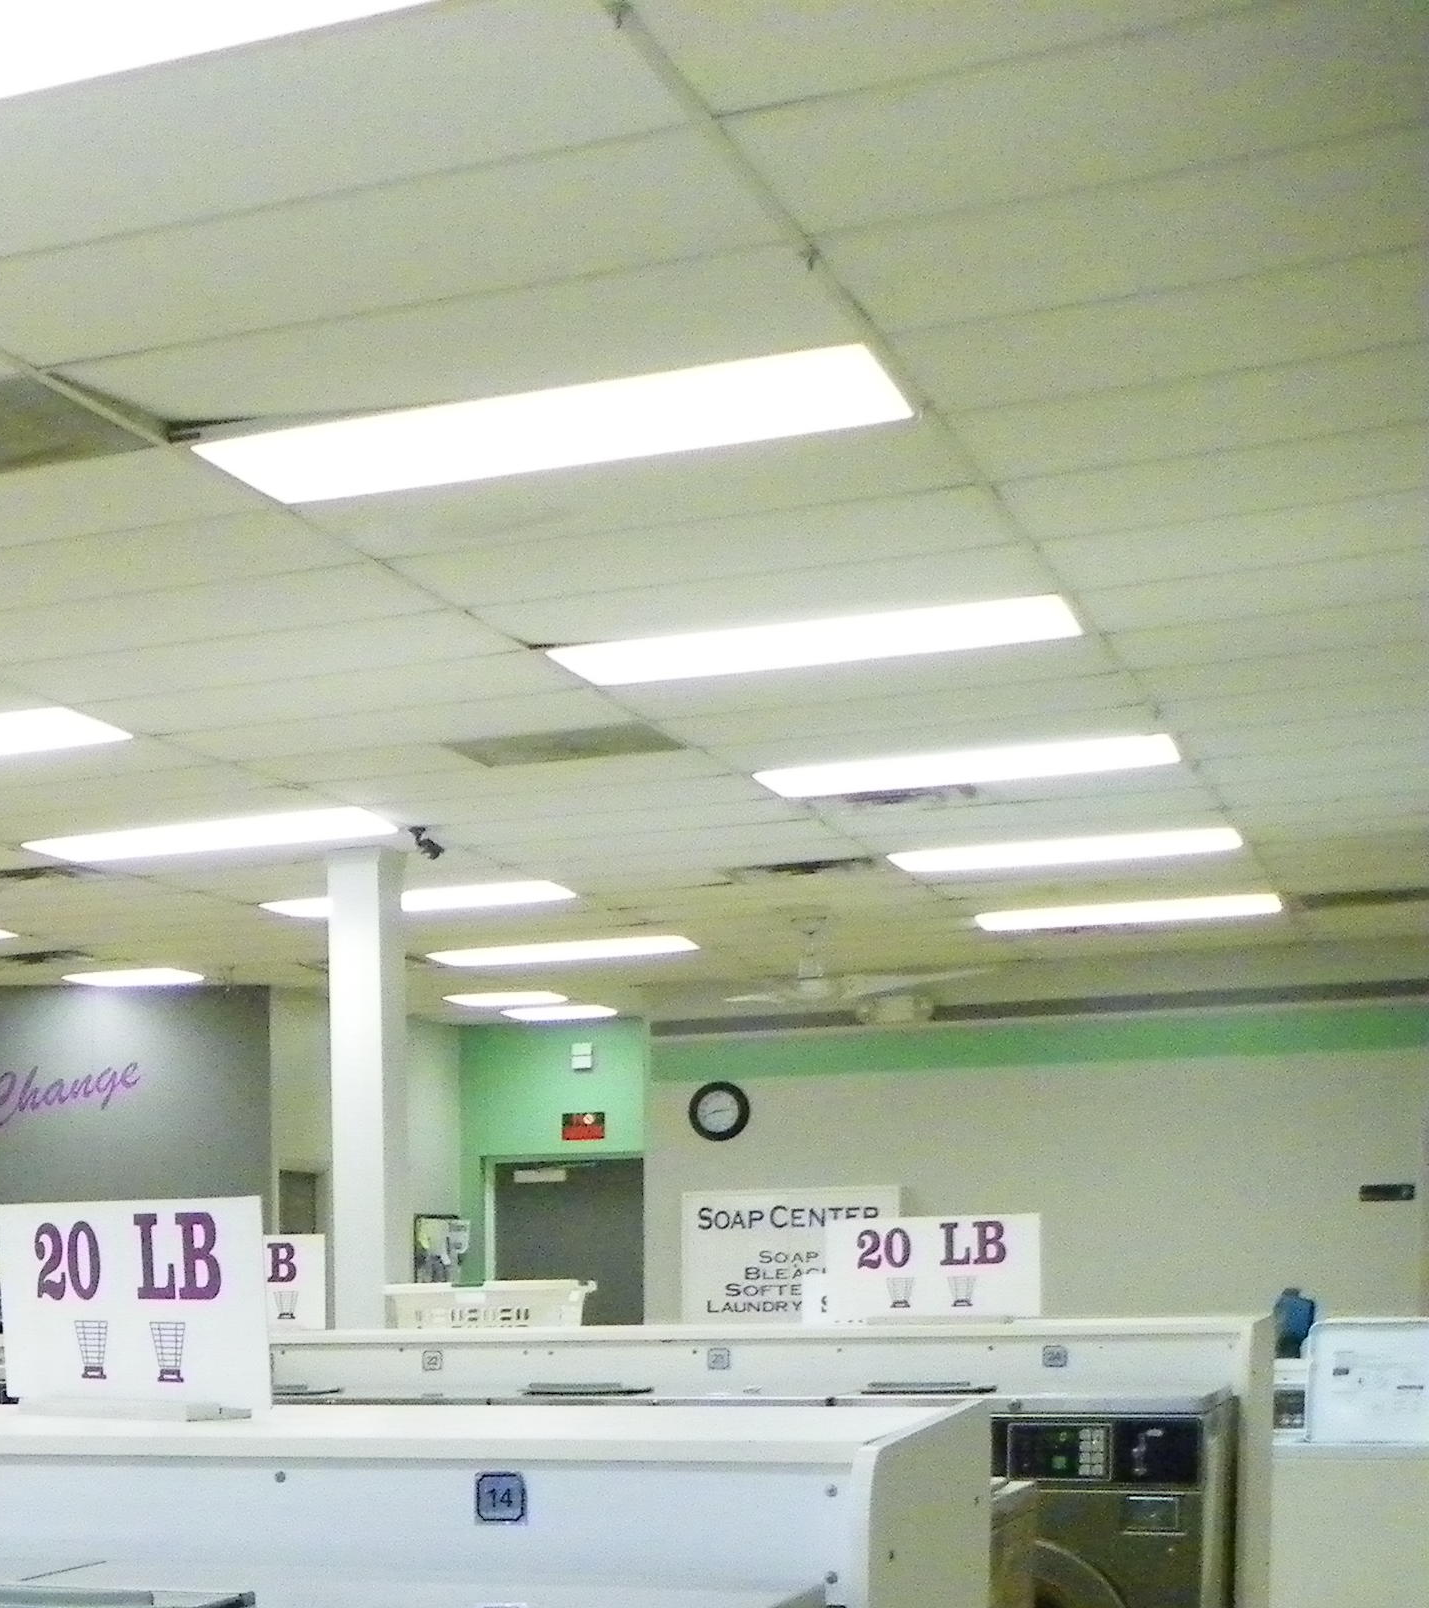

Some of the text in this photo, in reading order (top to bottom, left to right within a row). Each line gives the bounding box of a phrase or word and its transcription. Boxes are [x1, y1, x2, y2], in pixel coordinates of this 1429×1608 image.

[697, 1206, 765, 1230] SOAP
[34, 1211, 222, 1301] 20 LB
[857, 1220, 1007, 1270] 20 LB
[267, 1242, 297, 1283] B
[758, 1250, 820, 1264] SOAP
[725, 1283, 802, 1298] SOFTE
[706, 1300, 803, 1314] LAUNDRY
[487, 1487, 513, 1508] 14
